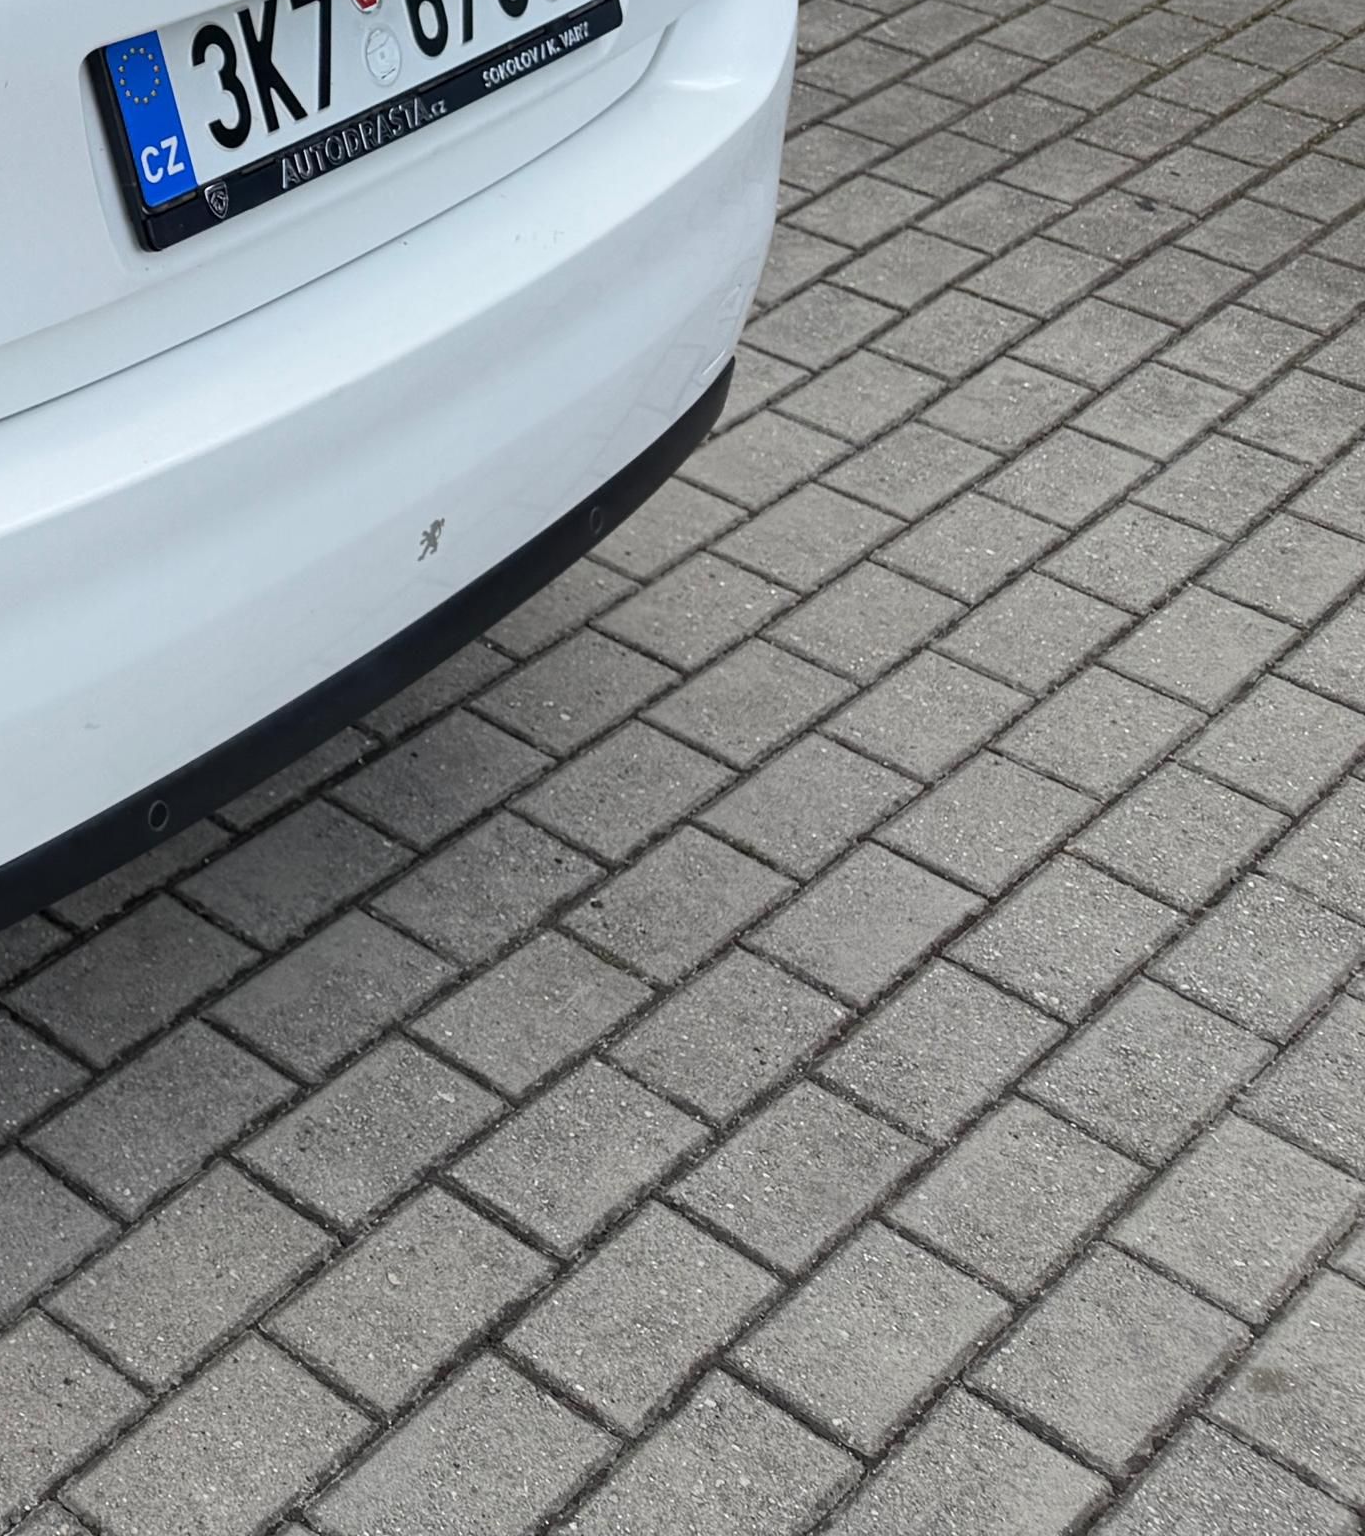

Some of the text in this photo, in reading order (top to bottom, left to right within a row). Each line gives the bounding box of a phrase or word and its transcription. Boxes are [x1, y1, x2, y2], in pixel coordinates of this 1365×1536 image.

[482, 42, 539, 88] SOKOLOV
[547, 37, 561, 55] K.
[140, 136, 185, 184] CZ
